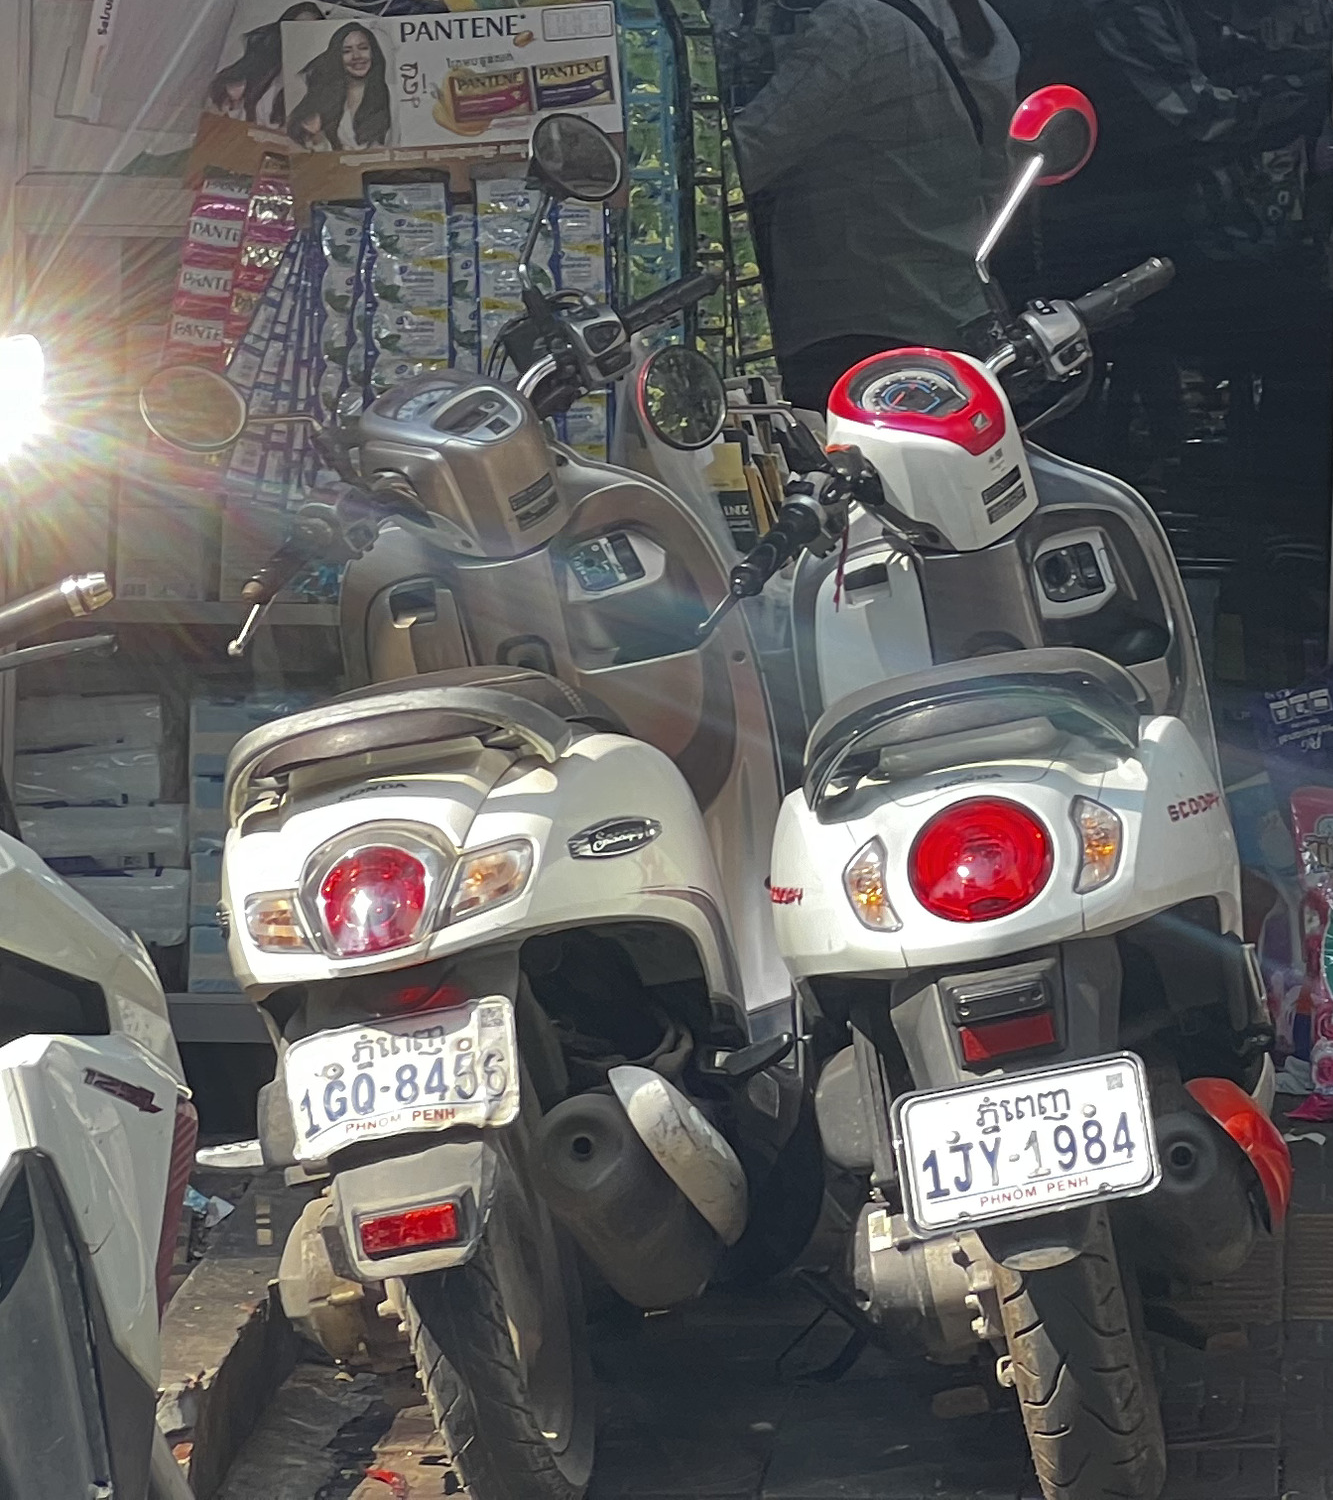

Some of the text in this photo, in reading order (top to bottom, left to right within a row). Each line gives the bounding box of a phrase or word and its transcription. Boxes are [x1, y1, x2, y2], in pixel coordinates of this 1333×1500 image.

[401, 14, 521, 42] PANTENE
[457, 71, 523, 90] PANTENE
[539, 61, 603, 80] PANTENE
[339, 782, 408, 801] HONDA
[352, 1026, 445, 1070] ភ្នំពេញ
[346, 1108, 456, 1135] PHNOM PENH
[977, 1088, 1071, 1136] ភ្នំពេញ
[921, 1112, 1136, 1201] 1JY-1984
[980, 1176, 1090, 1208] PHNOM PENH
